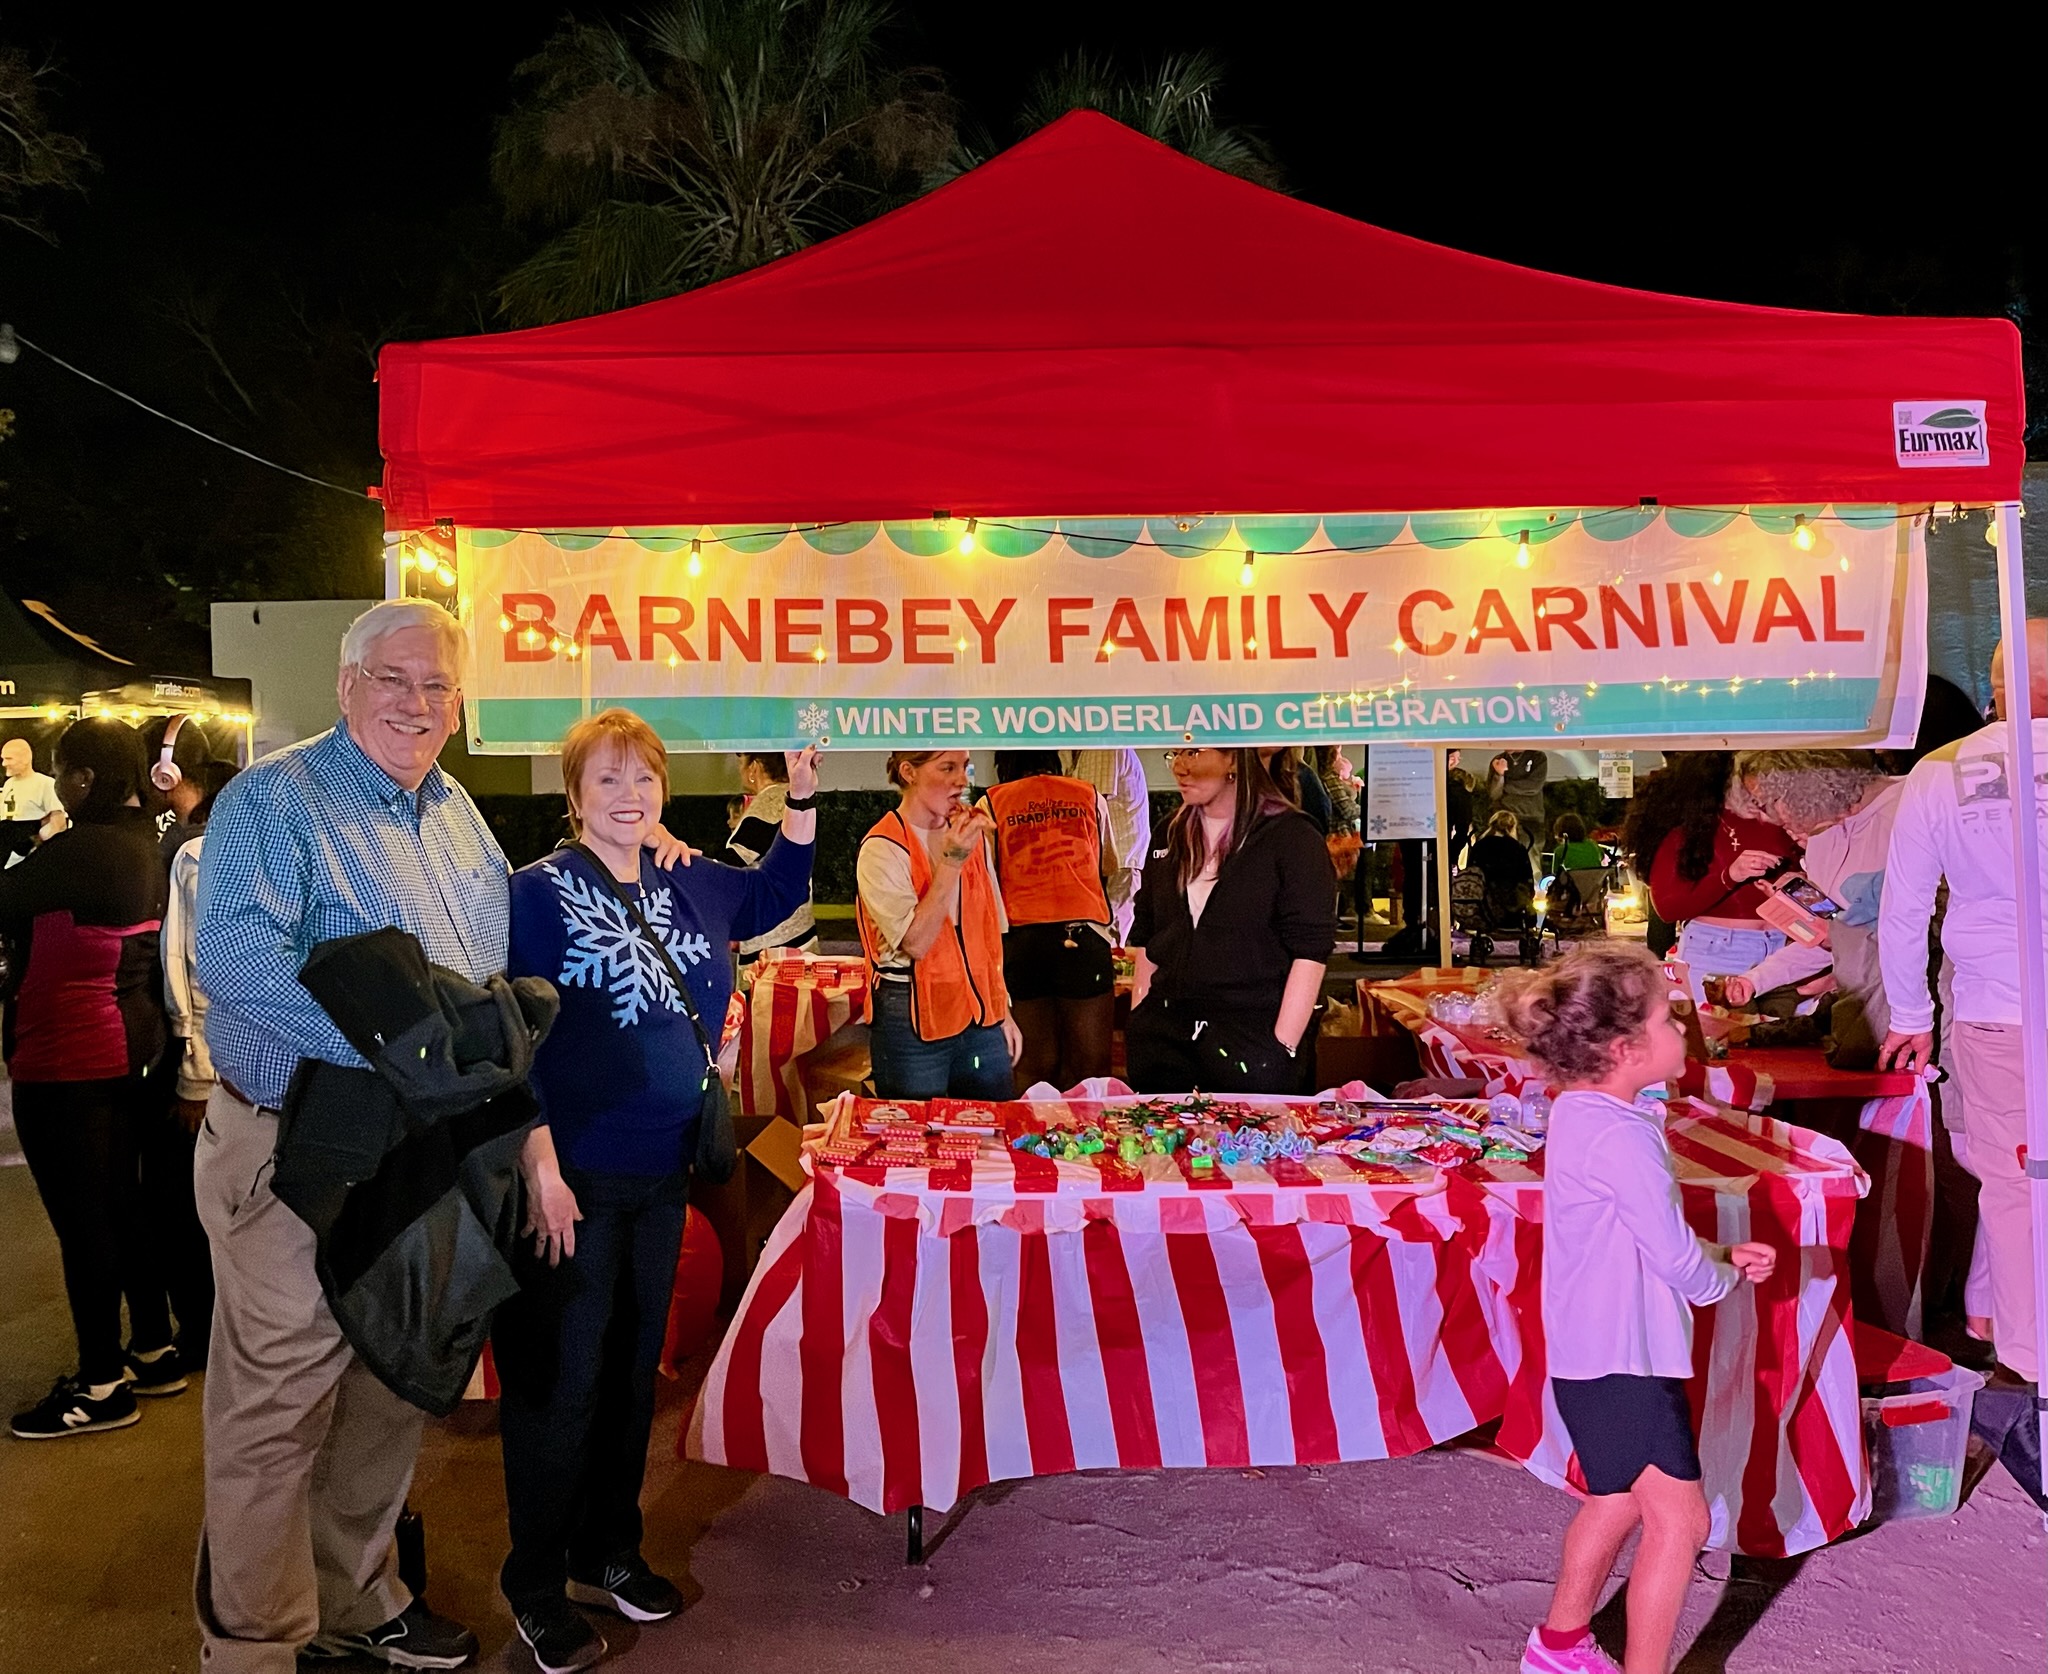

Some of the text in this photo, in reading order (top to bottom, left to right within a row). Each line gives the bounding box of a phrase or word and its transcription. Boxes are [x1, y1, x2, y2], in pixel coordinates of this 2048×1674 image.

[1898, 428, 1978, 453] Eurmax
[501, 575, 1865, 664] BARNEBEY FAMILY CARNIVAL
[837, 695, 1542, 736] WINTER WONDERLAND CELEBRATION
[1007, 807, 1087, 826] BRADENTON
